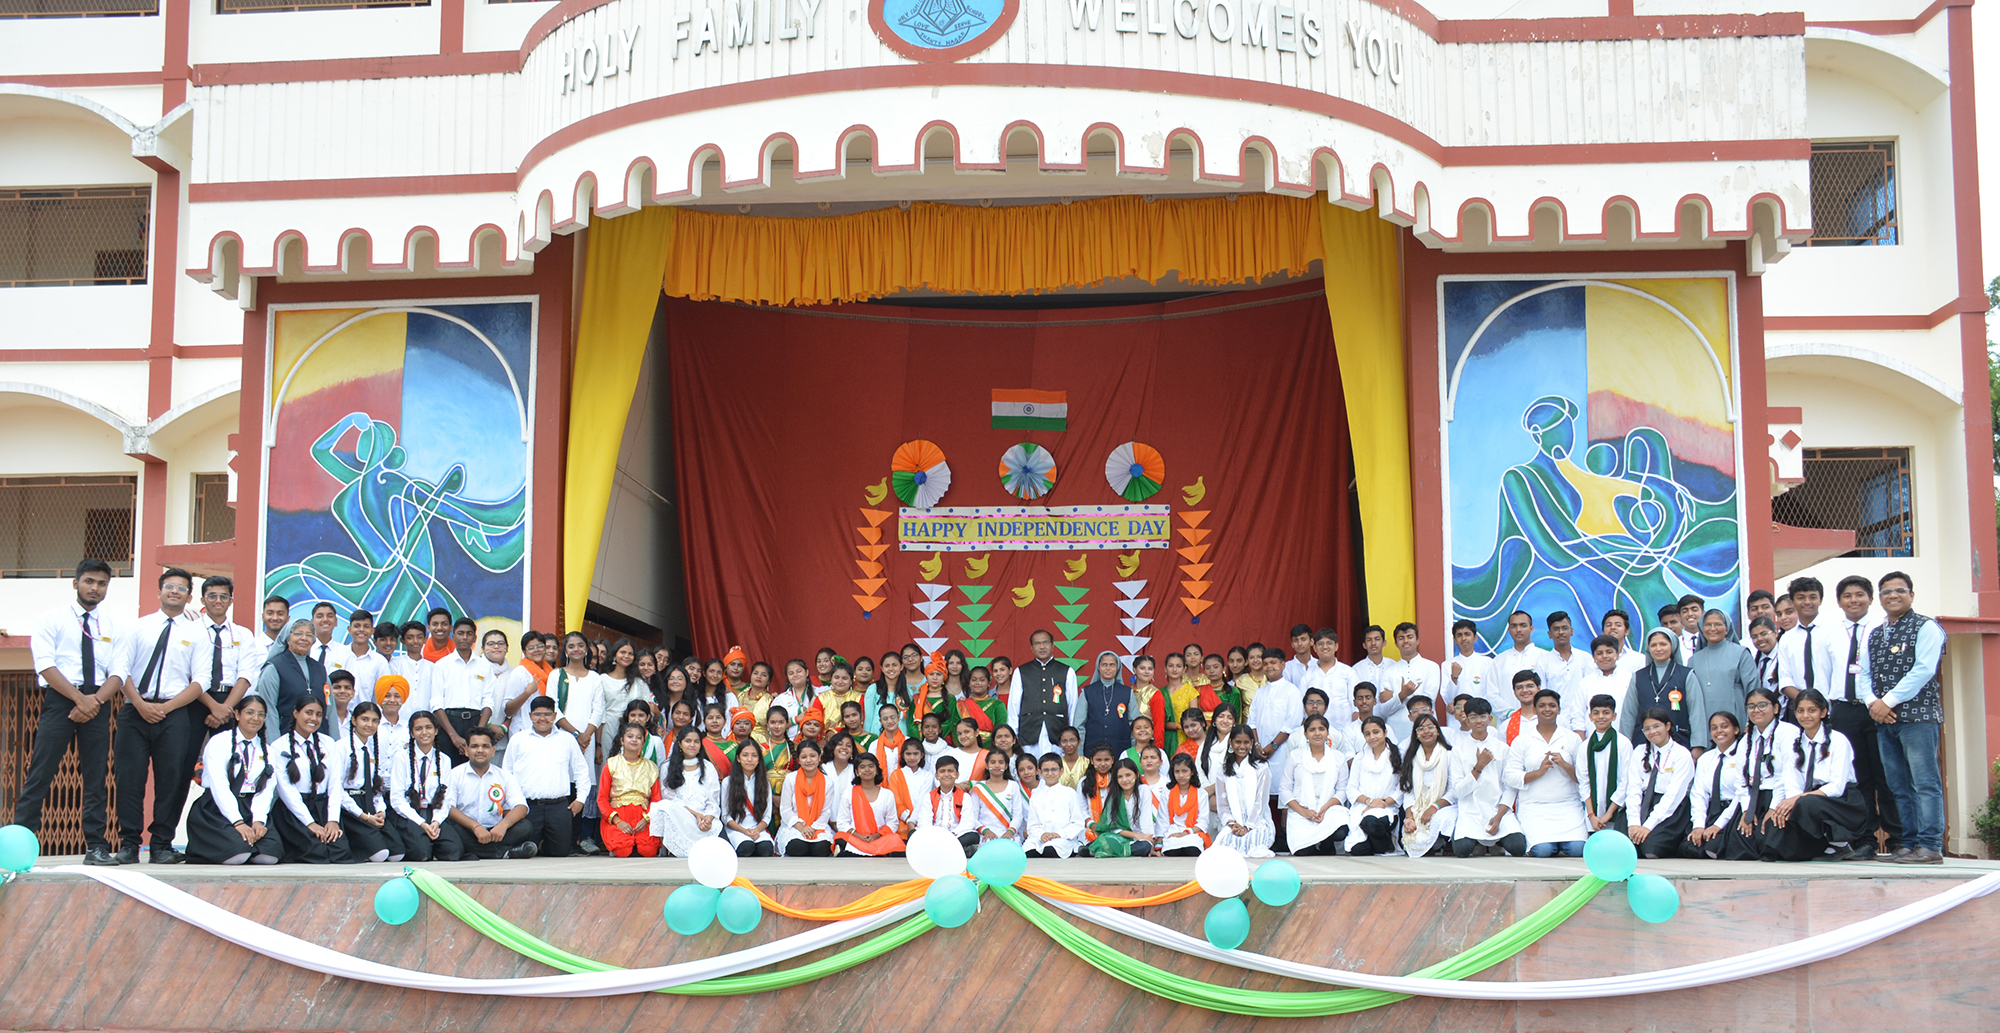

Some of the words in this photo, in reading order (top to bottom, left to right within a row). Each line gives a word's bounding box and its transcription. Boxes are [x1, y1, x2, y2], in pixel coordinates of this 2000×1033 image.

[967, 5, 985, 19] SCHOOL
[913, 21, 930, 30] LOVE
[945, 32, 966, 46] NAGAR
[560, 24, 640, 95] HOLY
[671, 0, 822, 60] FAMILY
[1068, 0, 1324, 58] WELCOMES
[1346, 20, 1404, 85] YOU
[903, 521, 968, 538] HAPPY
[977, 520, 1120, 537] INDEPENDENCE
[1127, 520, 1166, 536] DAY
